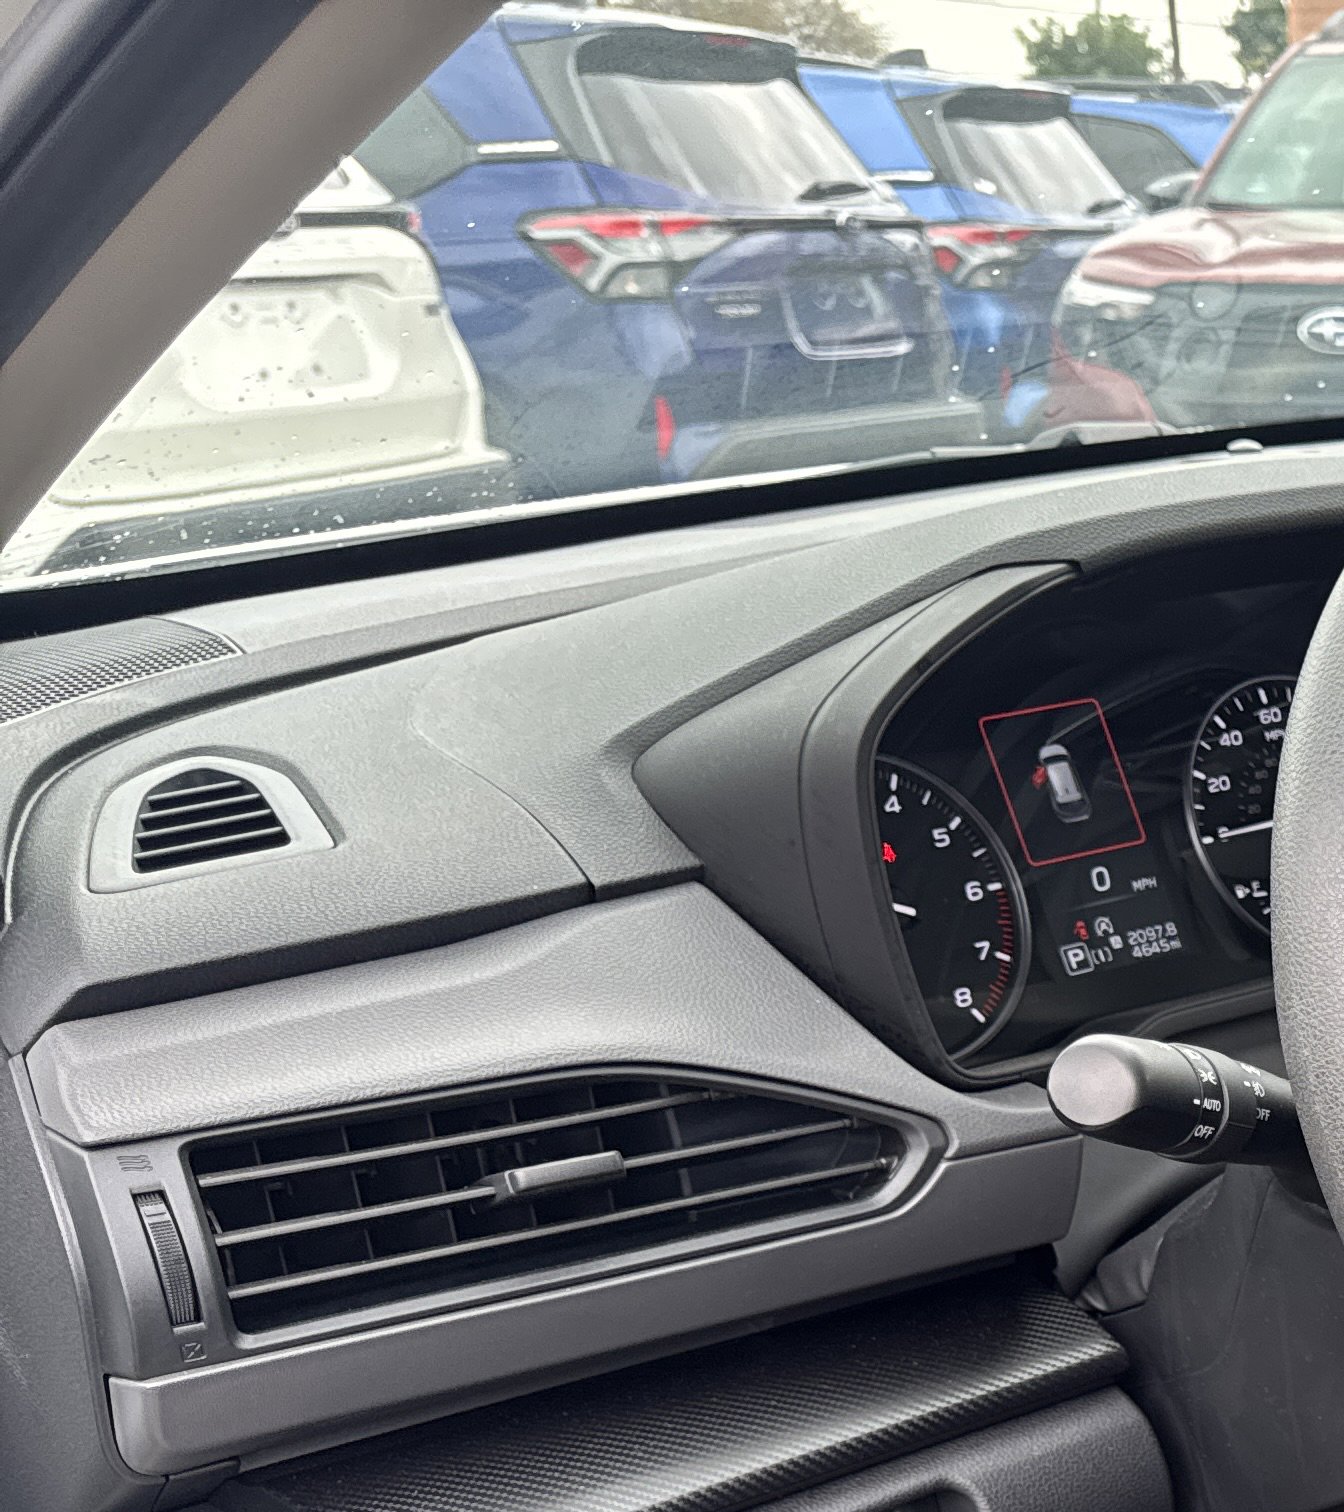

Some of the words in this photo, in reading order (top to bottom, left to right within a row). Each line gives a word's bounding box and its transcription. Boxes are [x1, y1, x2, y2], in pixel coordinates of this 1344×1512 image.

[1258, 707, 1282, 724] 60
[1219, 730, 1243, 746] 40
[1207, 775, 1231, 793] 20
[884, 795, 902, 813] 4
[932, 827, 951, 847] 5
[1091, 866, 1111, 892] 0
[1131, 876, 1157, 892] MPH
[964, 881, 984, 901] 6
[973, 940, 990, 960] 7
[1067, 948, 1085, 969] P
[953, 987, 972, 1008] 8
[1202, 1097, 1222, 1112] AUTO
[1193, 1124, 1216, 1139] OFF
